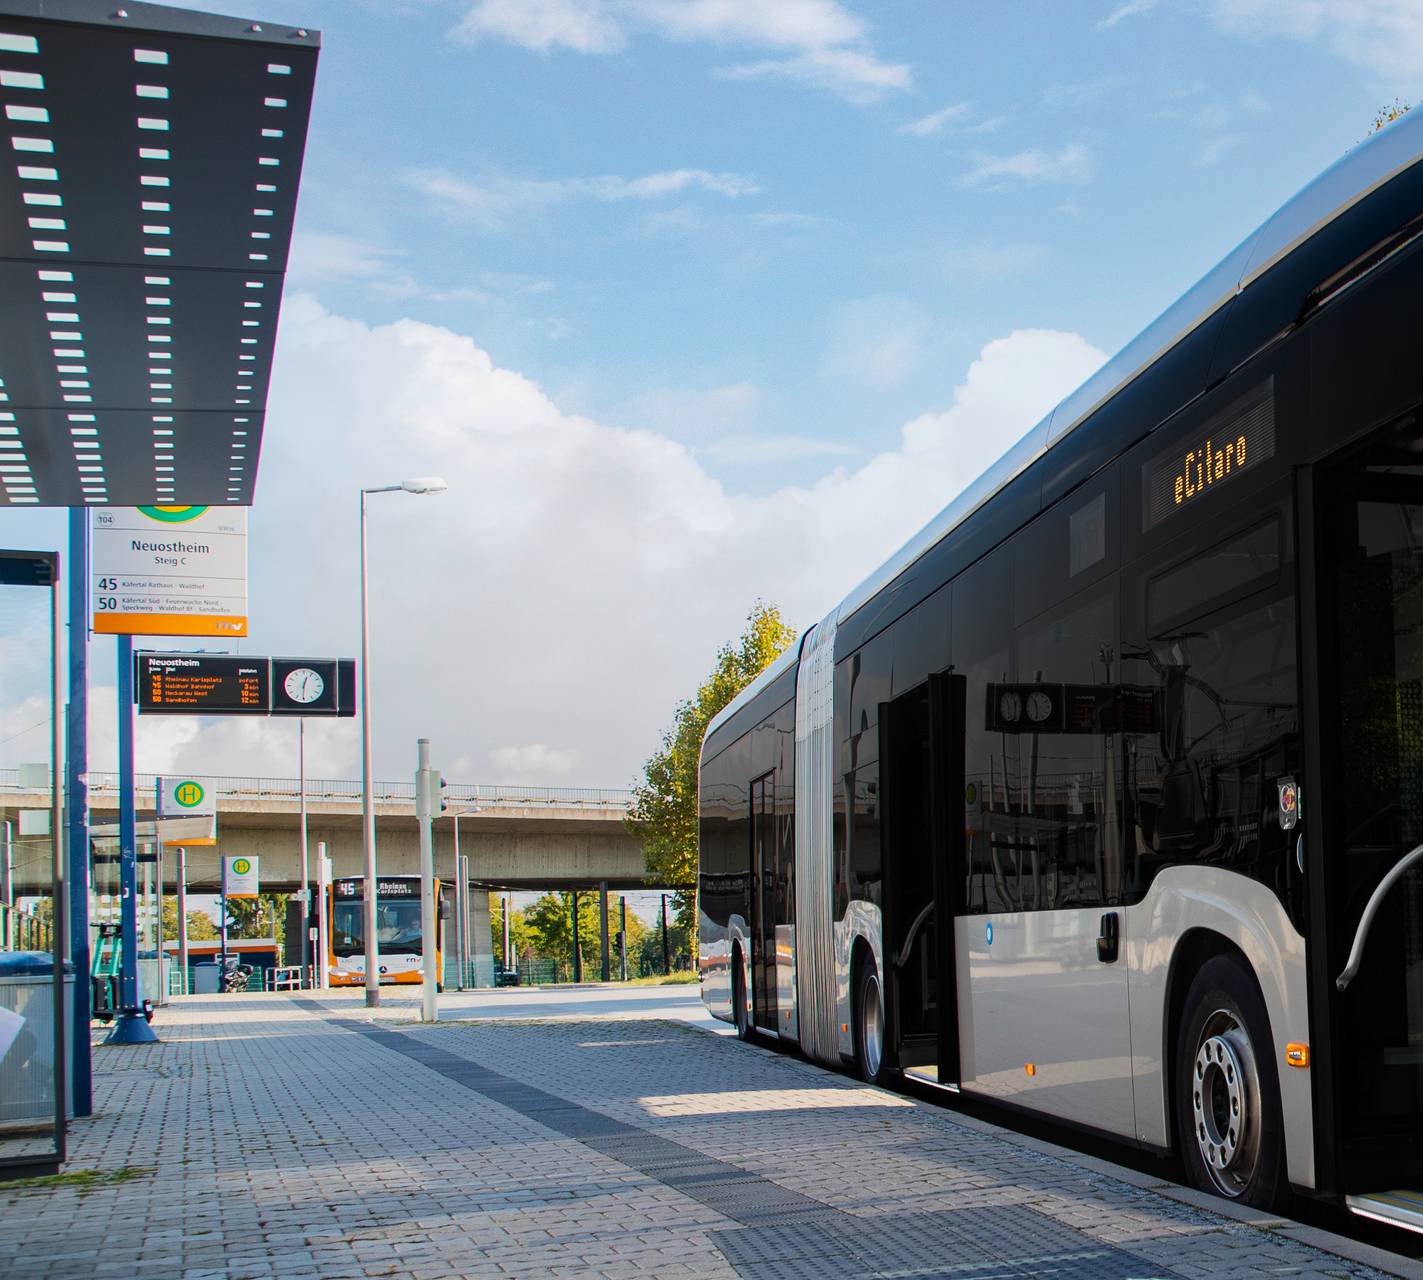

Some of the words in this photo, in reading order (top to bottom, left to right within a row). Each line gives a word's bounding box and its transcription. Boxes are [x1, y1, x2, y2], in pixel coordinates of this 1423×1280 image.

[1175, 436, 1246, 504] eCitaro
[98, 516, 113, 524] 104
[131, 540, 210, 554] Neuostheim
[154, 556, 178, 566] Steig
[180, 557, 187, 565] C
[98, 578, 118, 591] 45
[98, 597, 117, 610] 50
[148, 658, 200, 667] Neuostheim
[340, 882, 355, 896] 45
